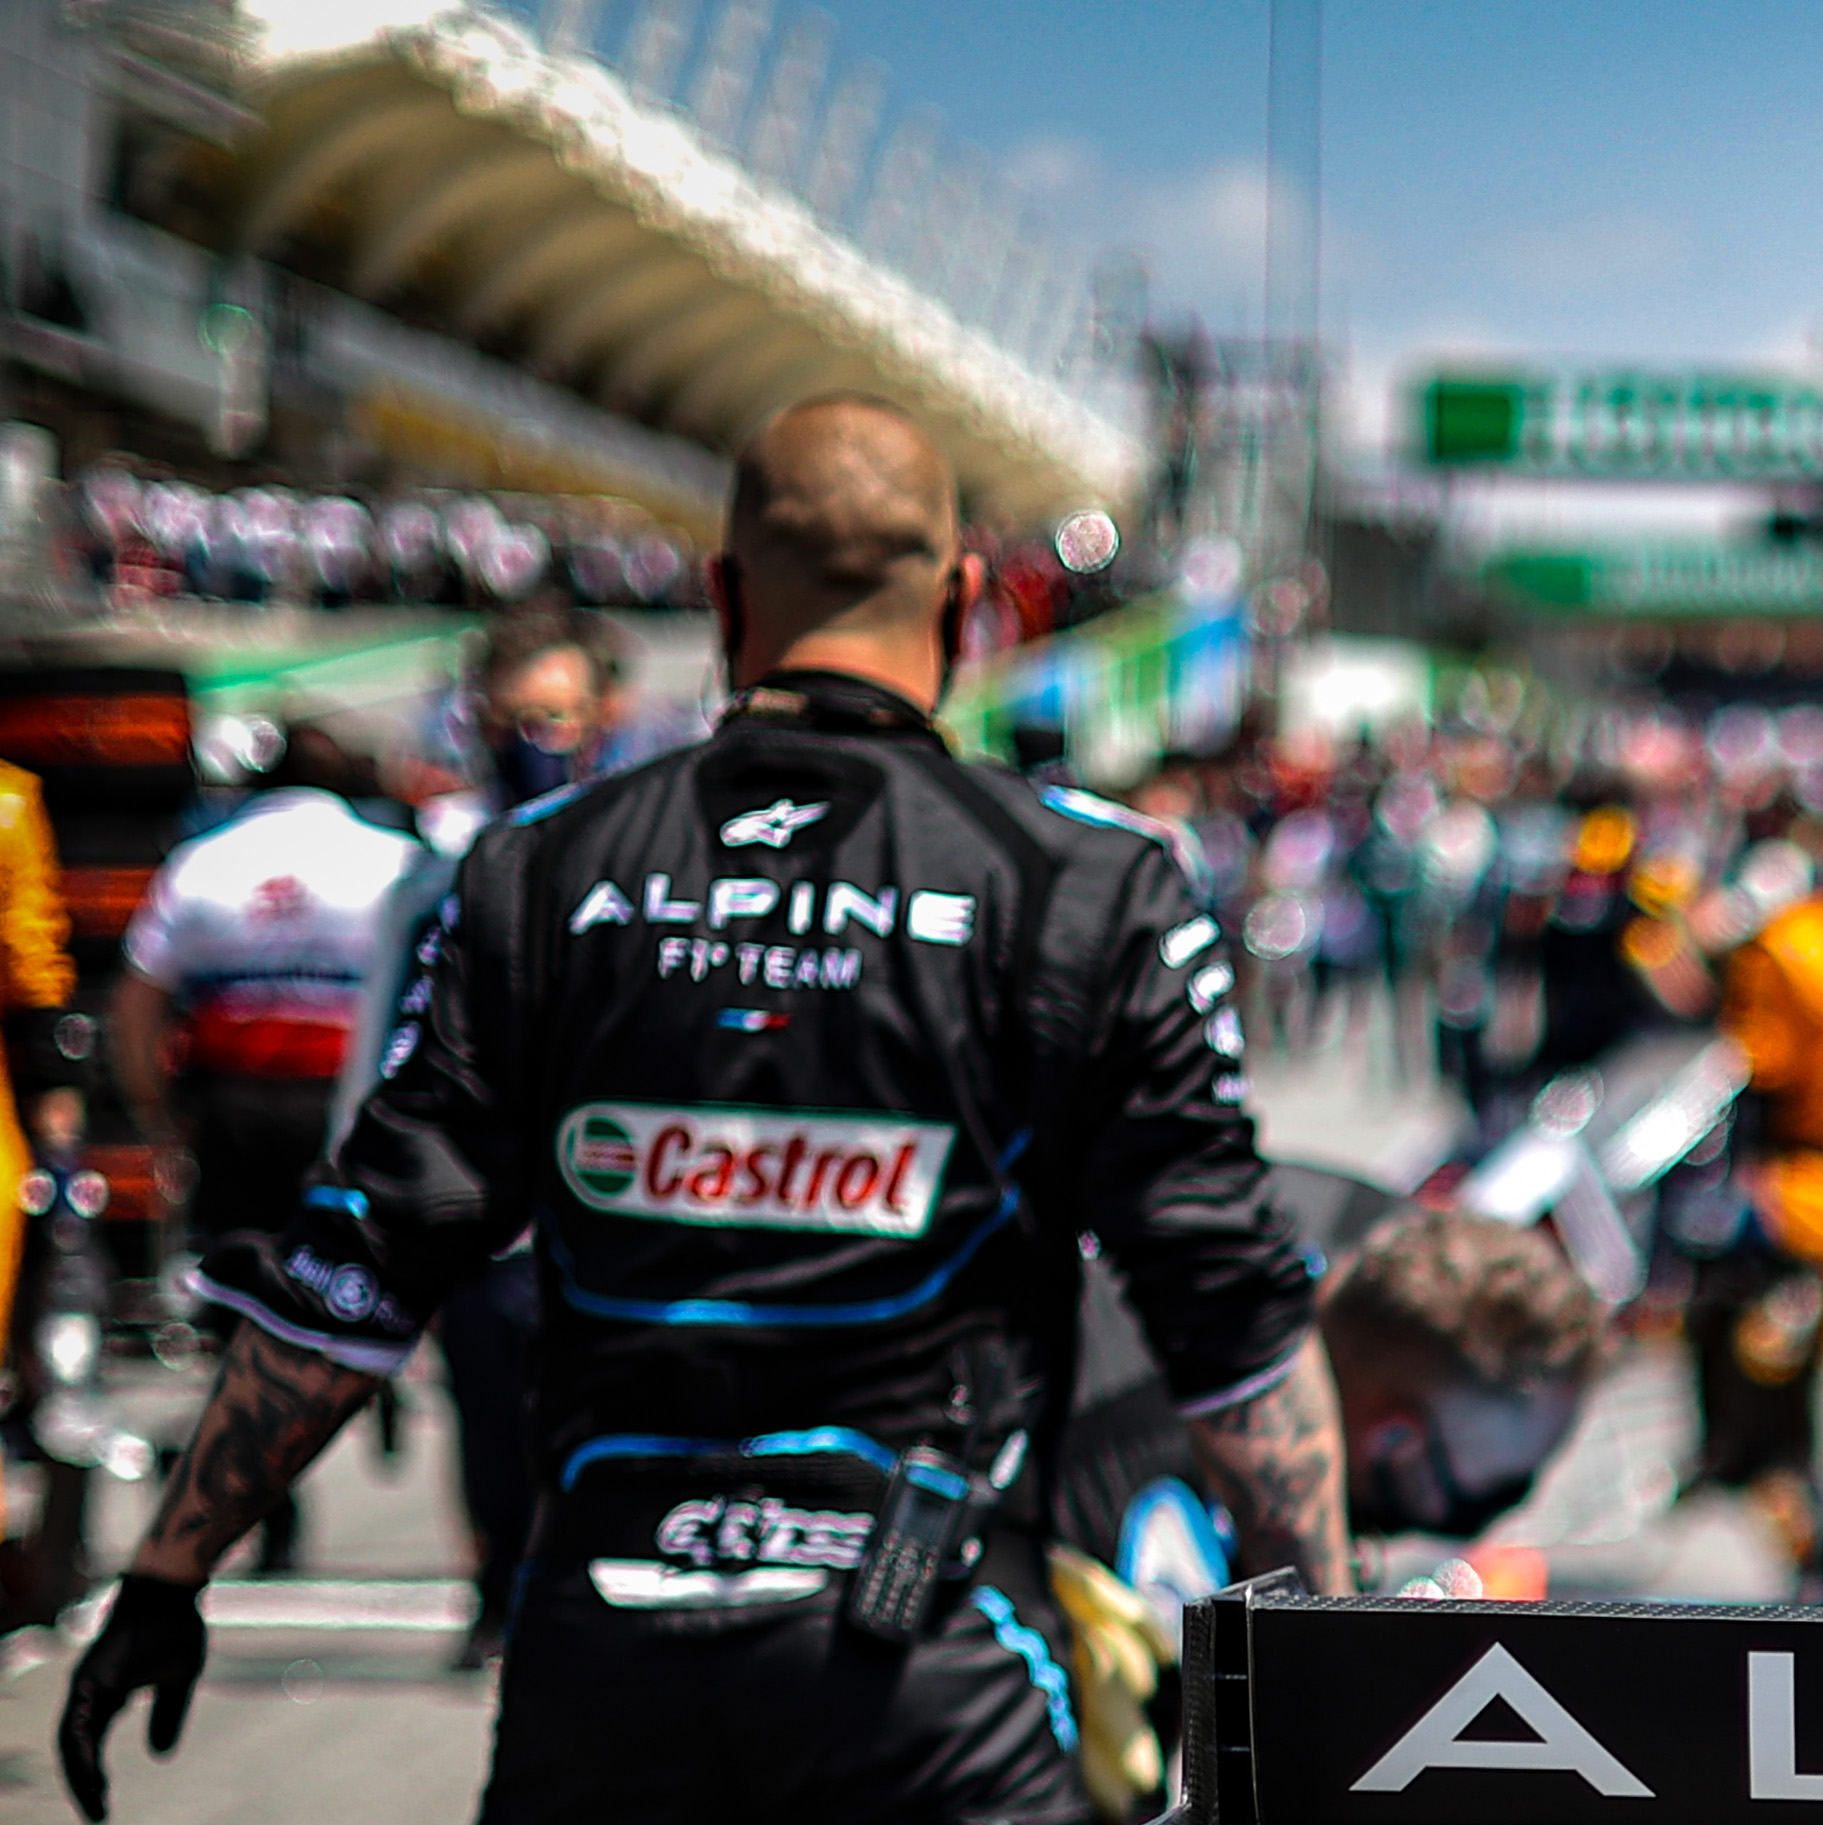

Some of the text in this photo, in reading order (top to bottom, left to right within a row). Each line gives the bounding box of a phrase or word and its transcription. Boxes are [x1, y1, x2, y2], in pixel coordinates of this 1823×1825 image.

[569, 873, 976, 946] ALPINE
[737, 943, 863, 990] TEAM
[645, 1123, 917, 1216] Castrol
